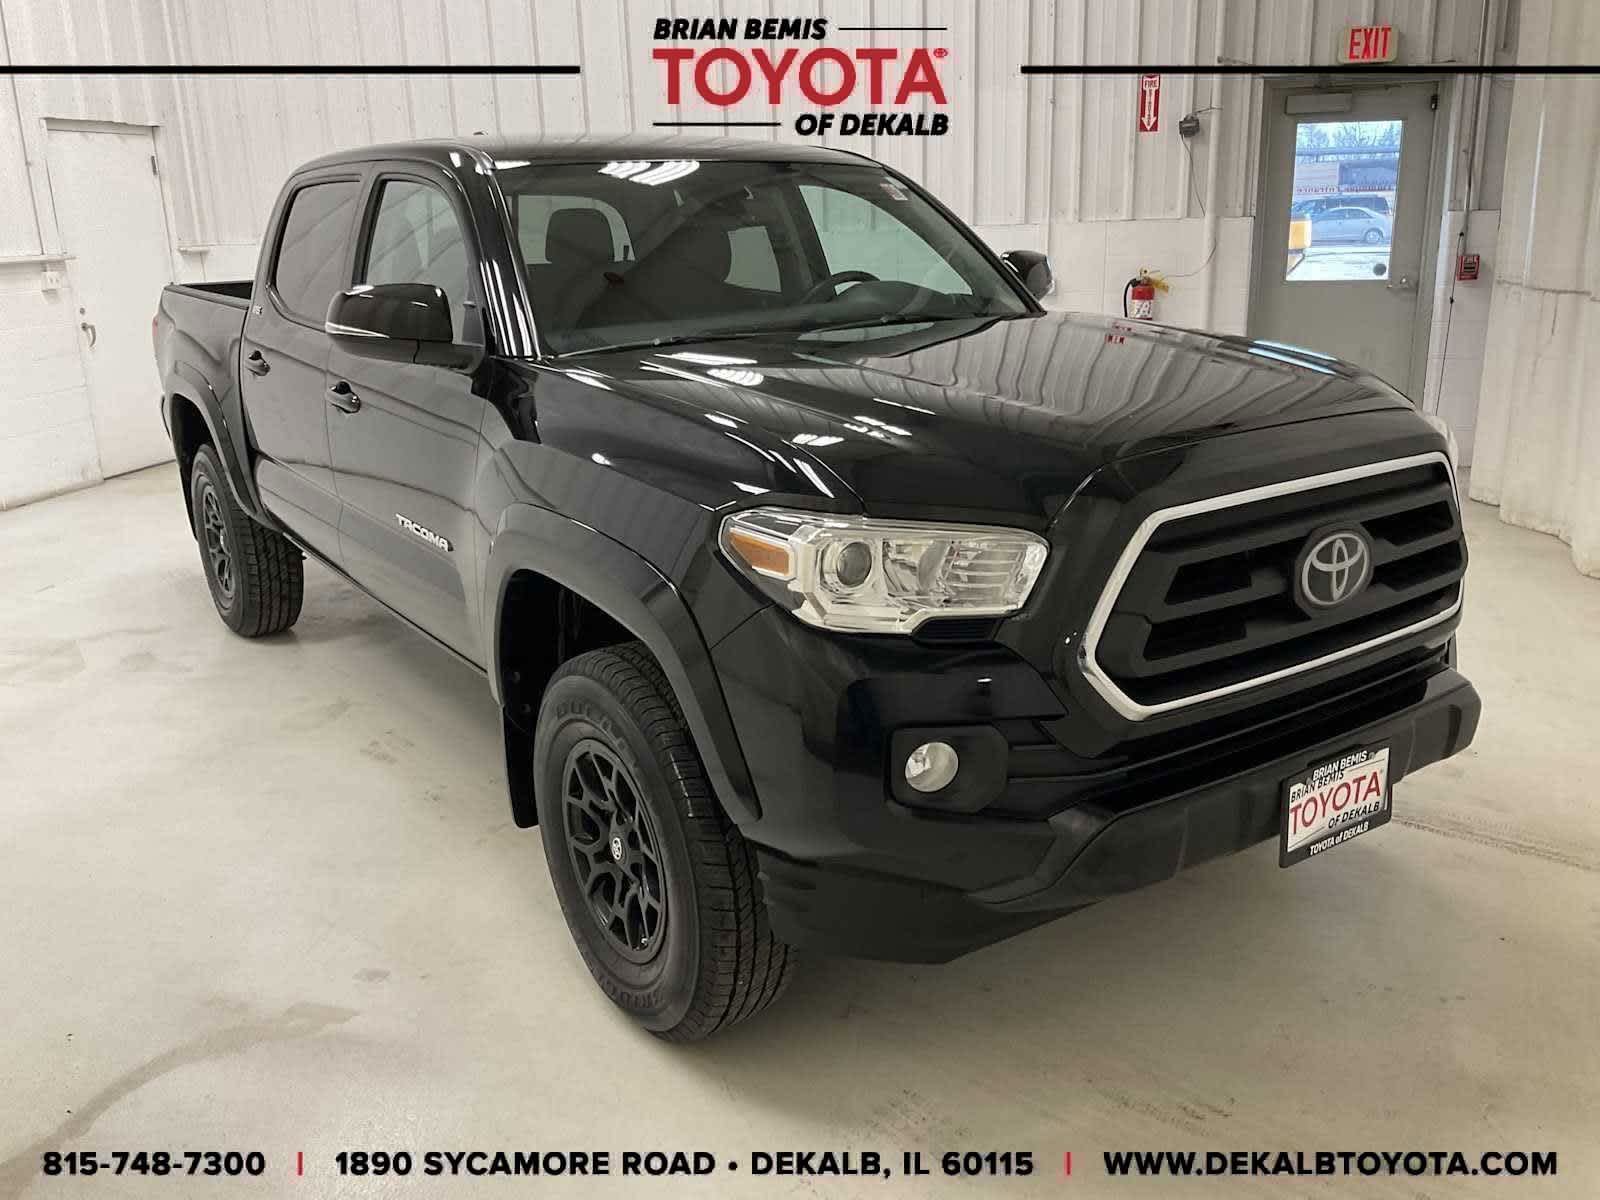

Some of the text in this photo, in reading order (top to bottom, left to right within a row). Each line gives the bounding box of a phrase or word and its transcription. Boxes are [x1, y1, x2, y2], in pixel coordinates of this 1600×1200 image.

[1349, 27, 1391, 60] EXIT
[1144, 79, 1158, 88] FIRE
[396, 513, 449, 552] TACOMA
[1313, 750, 1368, 781] BRIAN BEMIS
[1290, 771, 1381, 835] TOYOTA
[1291, 781, 1316, 803] BRIAN
[1328, 801, 1380, 829] OF DEKALB
[1310, 836, 1335, 856] TOYOTA
[1343, 821, 1369, 841] DEKALB
